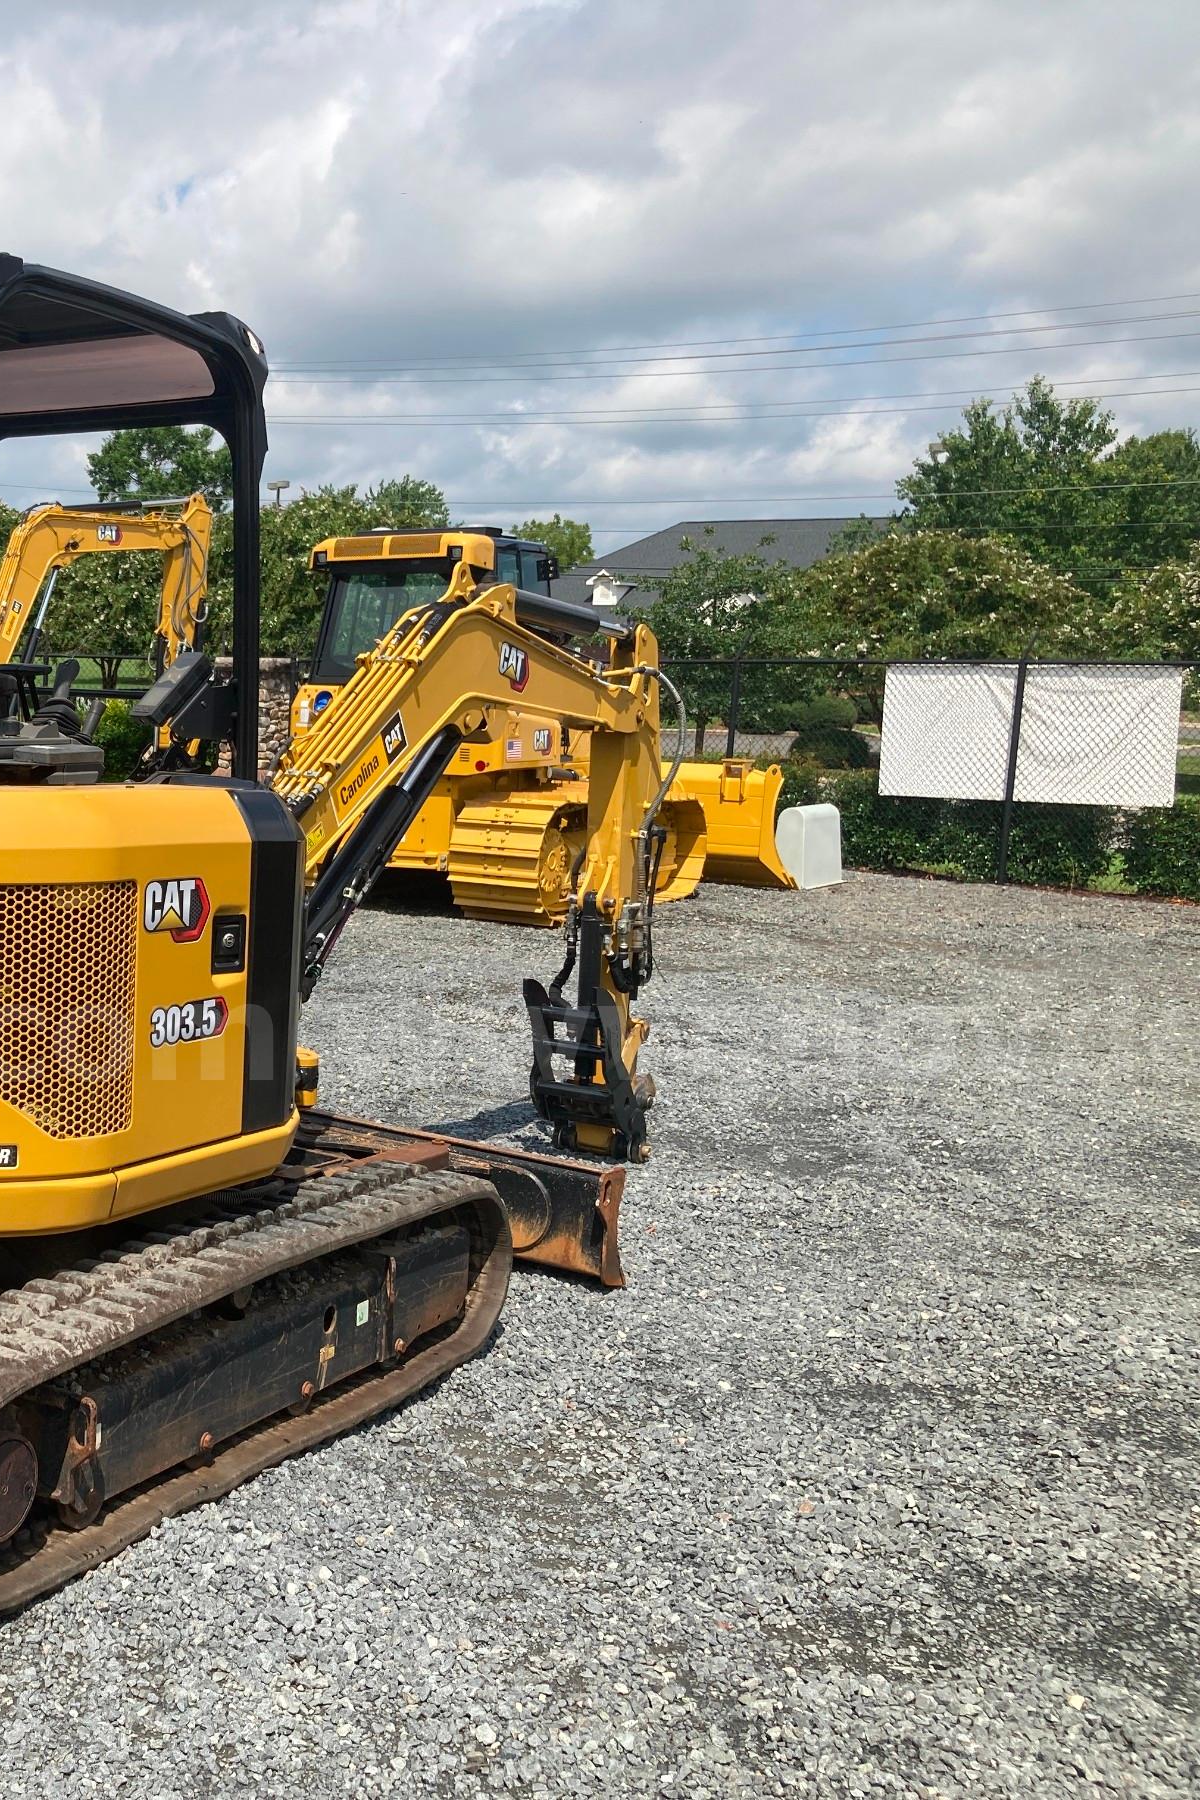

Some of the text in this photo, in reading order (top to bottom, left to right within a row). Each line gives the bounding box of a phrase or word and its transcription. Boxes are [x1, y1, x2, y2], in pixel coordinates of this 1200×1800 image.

[97, 525, 117, 541] CAT
[499, 642, 525, 682] CAT
[534, 729, 549, 751] CAT
[339, 722, 402, 806] Carolina CAT
[145, 879, 196, 931] CAT
[151, 999, 216, 1046] 303.5
